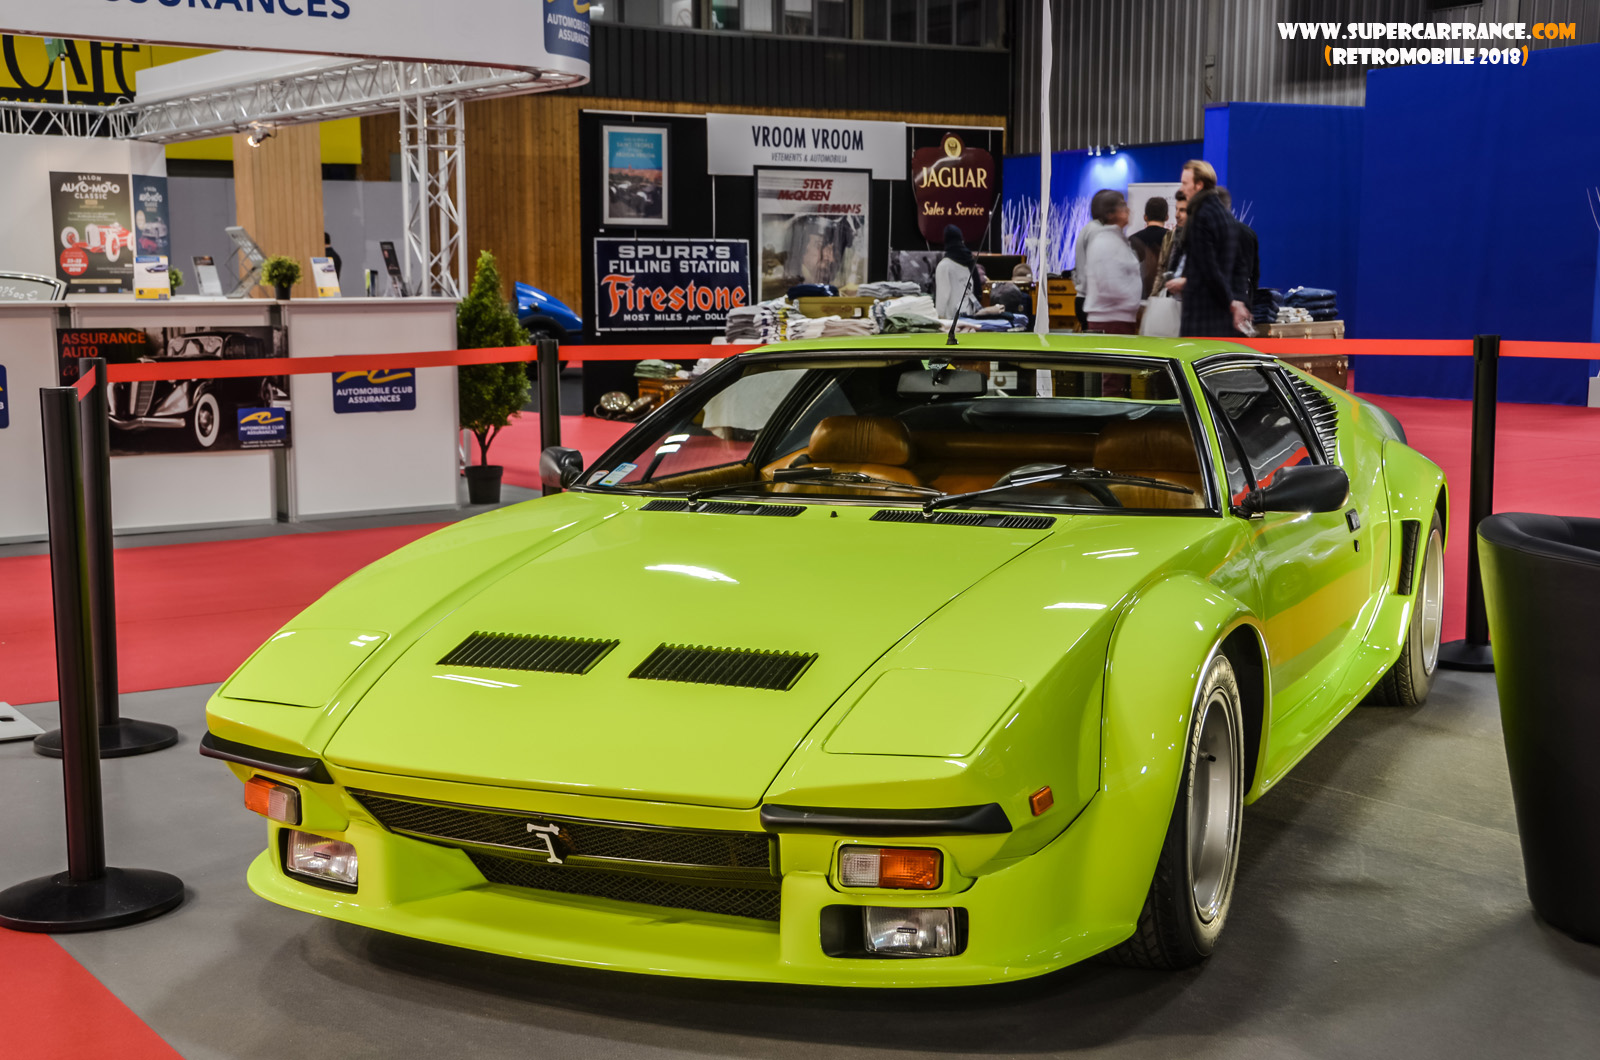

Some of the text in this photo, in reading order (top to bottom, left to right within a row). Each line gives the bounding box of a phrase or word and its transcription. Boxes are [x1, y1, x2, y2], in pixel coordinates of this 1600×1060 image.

[751, 125, 864, 151] VROOM VROOM
[771, 152, 803, 162] VETEMENTS
[810, 154, 848, 164] AUTOMOBILIA
[919, 166, 988, 189] JAGUAR
[61, 181, 121, 194] AUTO-MOTO
[802, 178, 834, 190] STEVE
[74, 192, 108, 200] CLASSIC
[777, 189, 831, 201] McQUEEN
[831, 204, 862, 214] MANS
[922, 201, 945, 216] Sales
[954, 201, 985, 216] Service
[618, 244, 731, 259] SPURR'S
[609, 260, 740, 274] FILLING STATION
[600, 273, 746, 318] Firestone
[623, 313, 728, 323] MOST MILES per DOLL
[62, 332, 146, 345] ASSURANCE
[62, 346, 99, 358] AUTO
[336, 386, 413, 396] AUTOMOBILE CLUB
[348, 394, 401, 404] ASSURANCES
